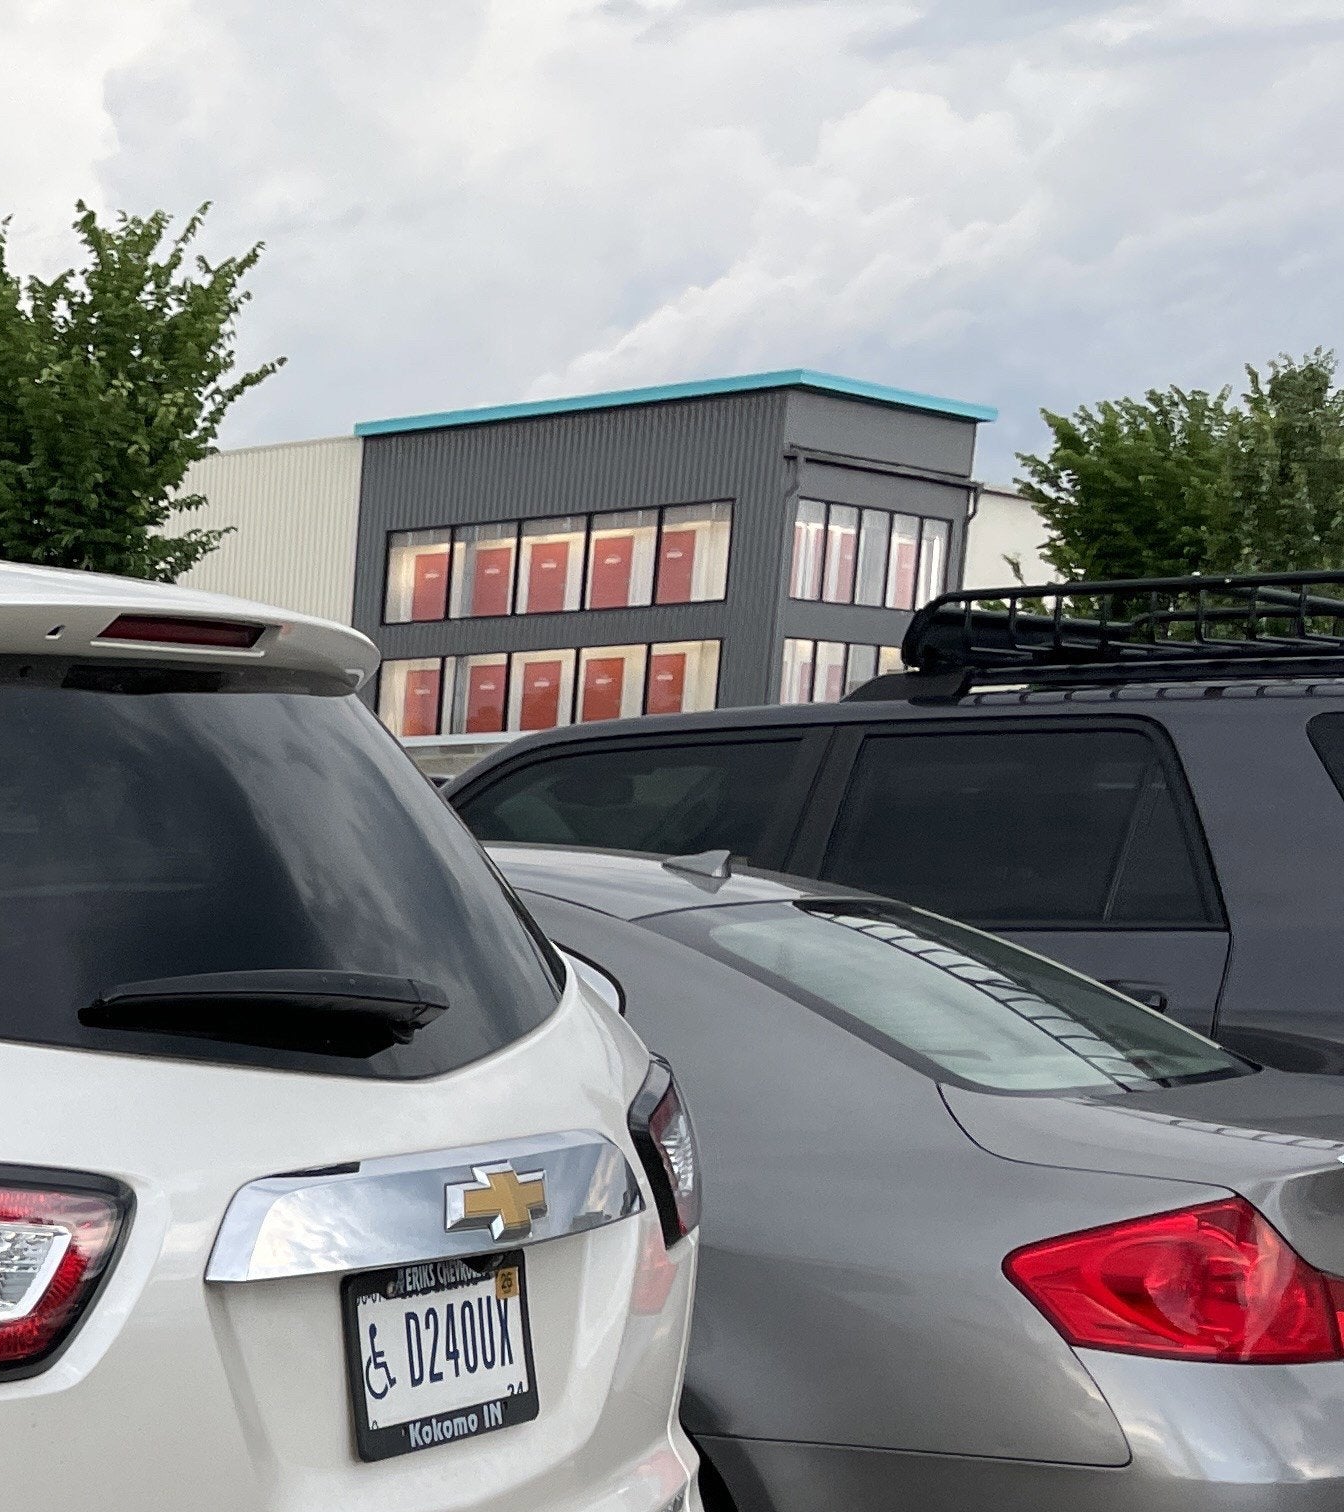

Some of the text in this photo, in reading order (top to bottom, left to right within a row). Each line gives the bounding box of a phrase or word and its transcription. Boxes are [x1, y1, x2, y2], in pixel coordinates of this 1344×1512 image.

[405, 1295, 514, 1389] D240UX
[408, 1400, 504, 1448] Kokomo IN
